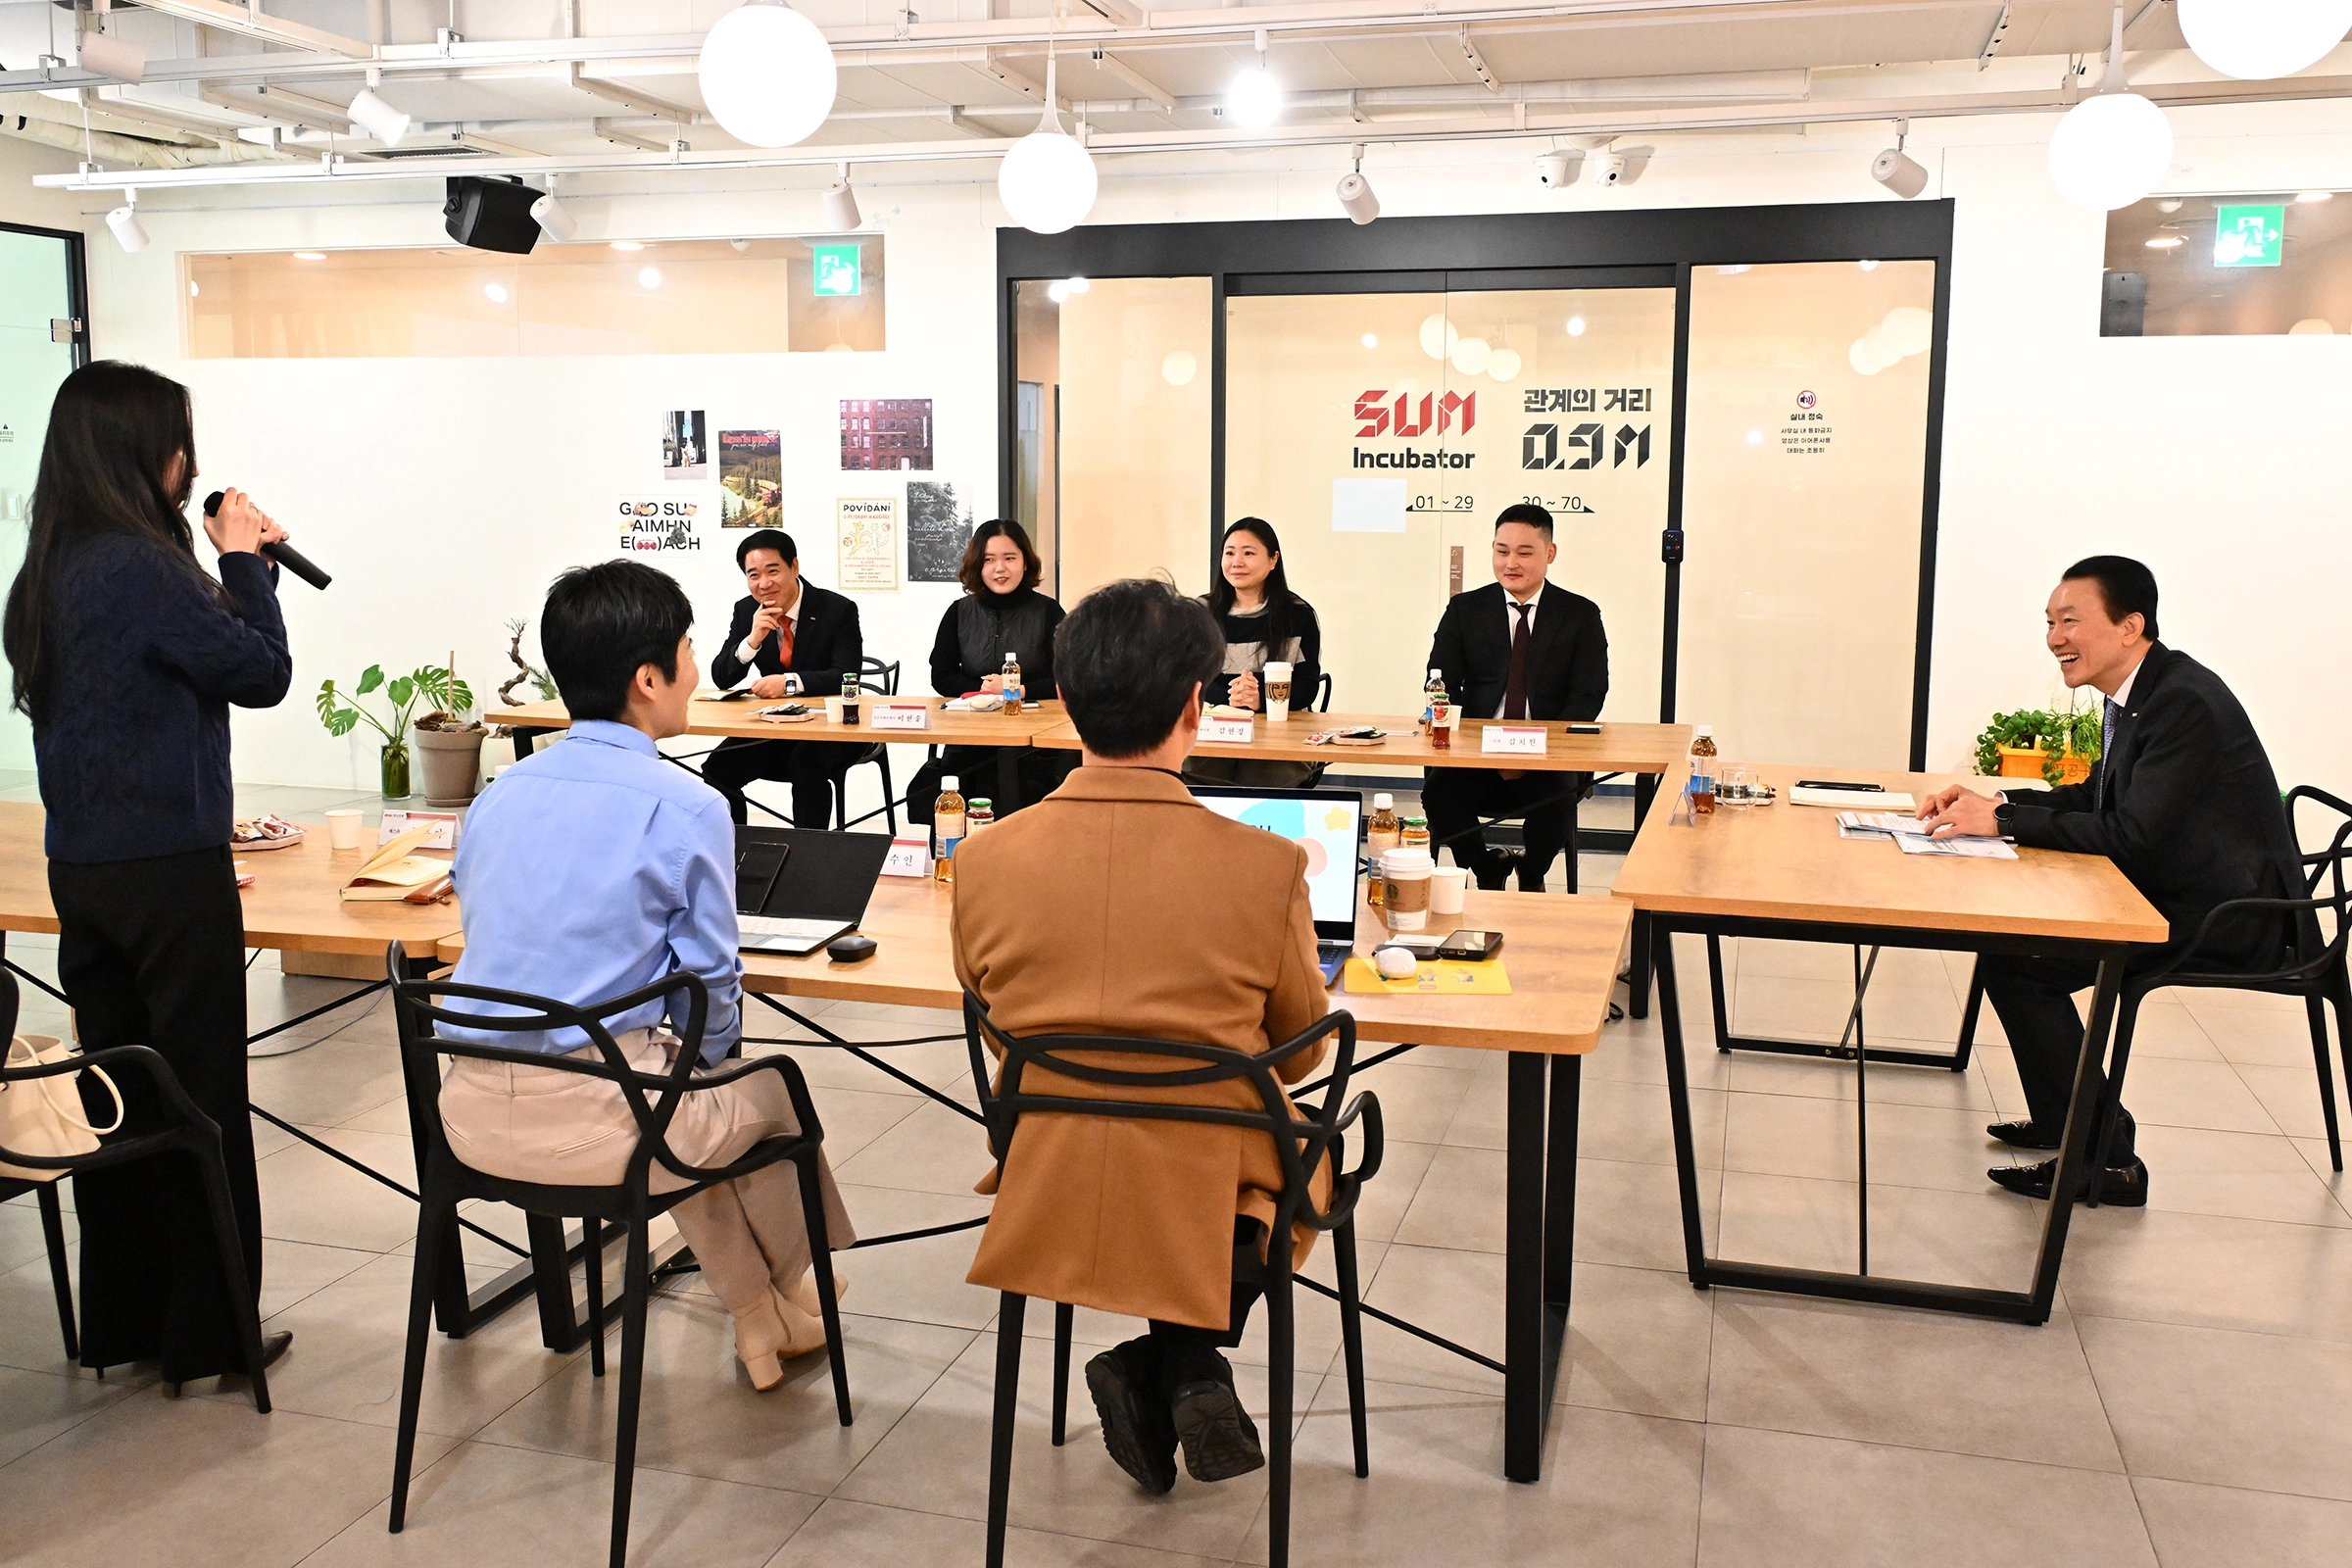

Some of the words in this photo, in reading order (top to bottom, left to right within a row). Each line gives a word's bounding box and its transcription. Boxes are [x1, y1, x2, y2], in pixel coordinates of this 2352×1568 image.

[1524, 388, 1595, 413] 관계의
[1603, 388, 1651, 412] 거리
[1354, 390, 1476, 437] SUM
[1790, 413, 1806, 421] 실내
[1808, 413, 1824, 421] 정숙
[1353, 447, 1476, 468] Incubator
[1415, 495, 1434, 509] 01
[1454, 495, 1474, 510] 29
[1561, 496, 1581, 510] 70
